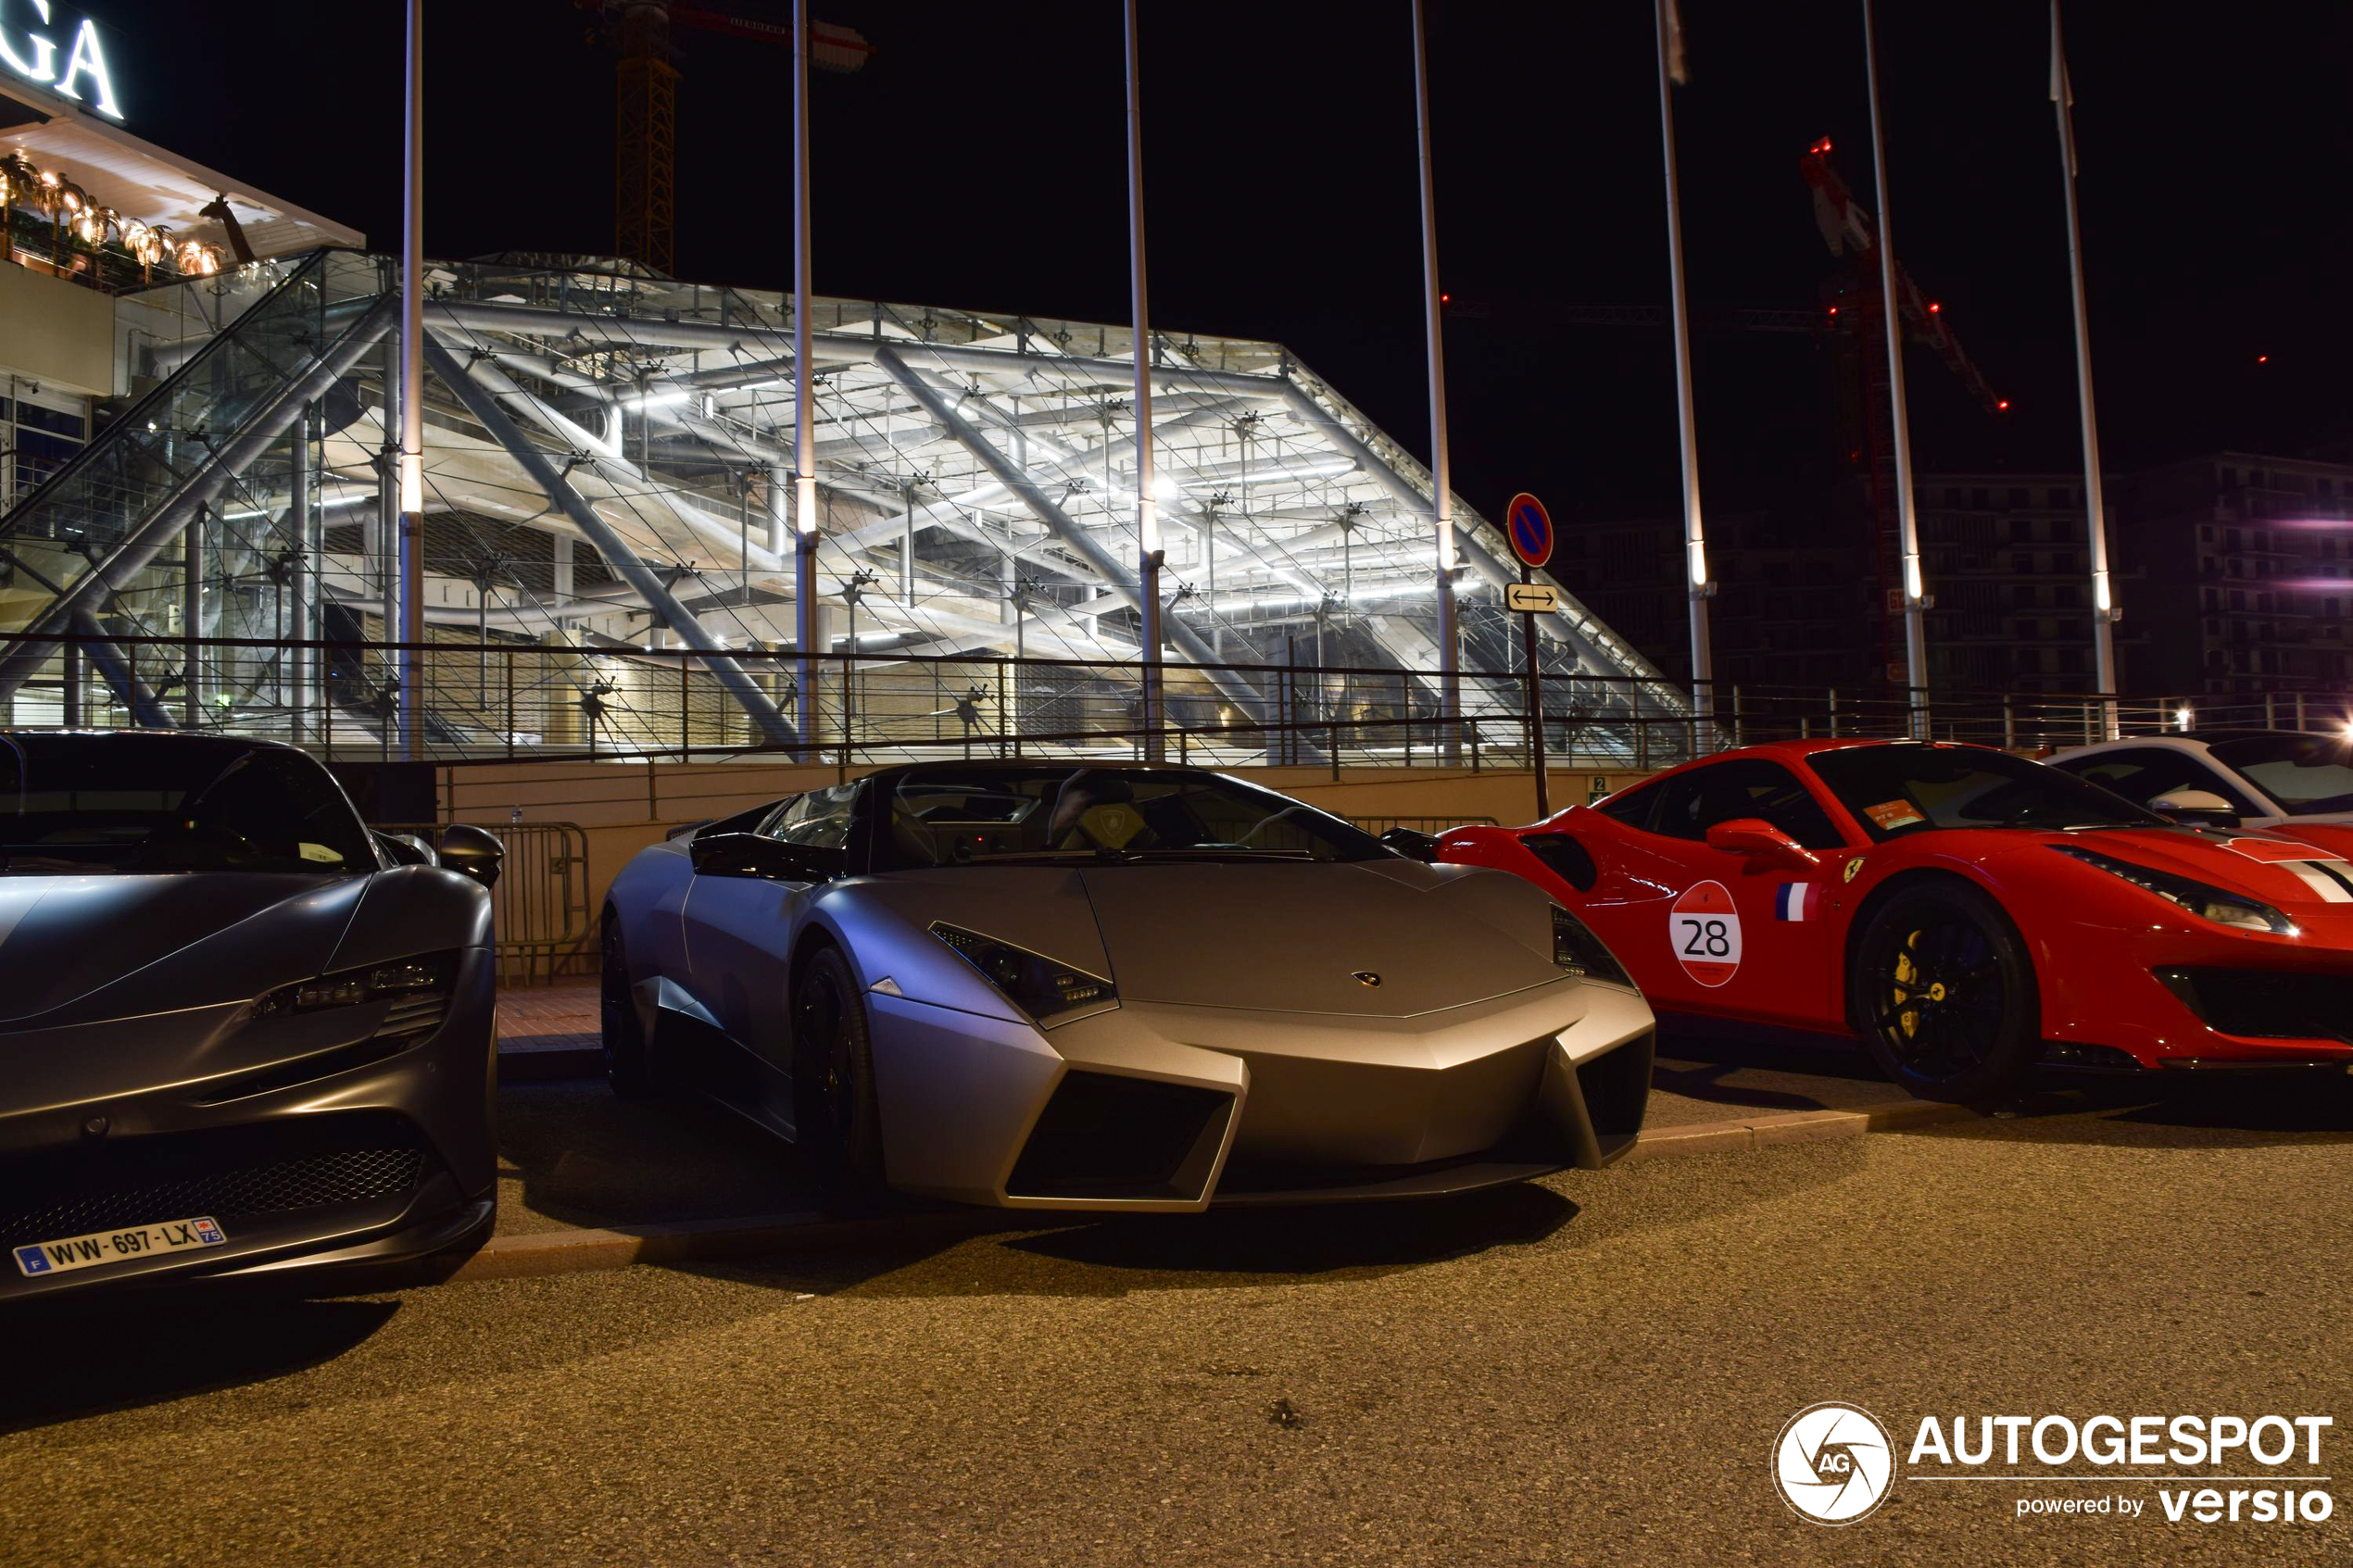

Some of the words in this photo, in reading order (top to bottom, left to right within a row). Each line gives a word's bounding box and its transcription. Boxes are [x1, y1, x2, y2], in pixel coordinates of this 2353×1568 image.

[1596, 778, 1604, 790] 2
[1681, 920, 1730, 957] 28
[31, 1261, 41, 1269] F
[201, 1231, 221, 1242] 75
